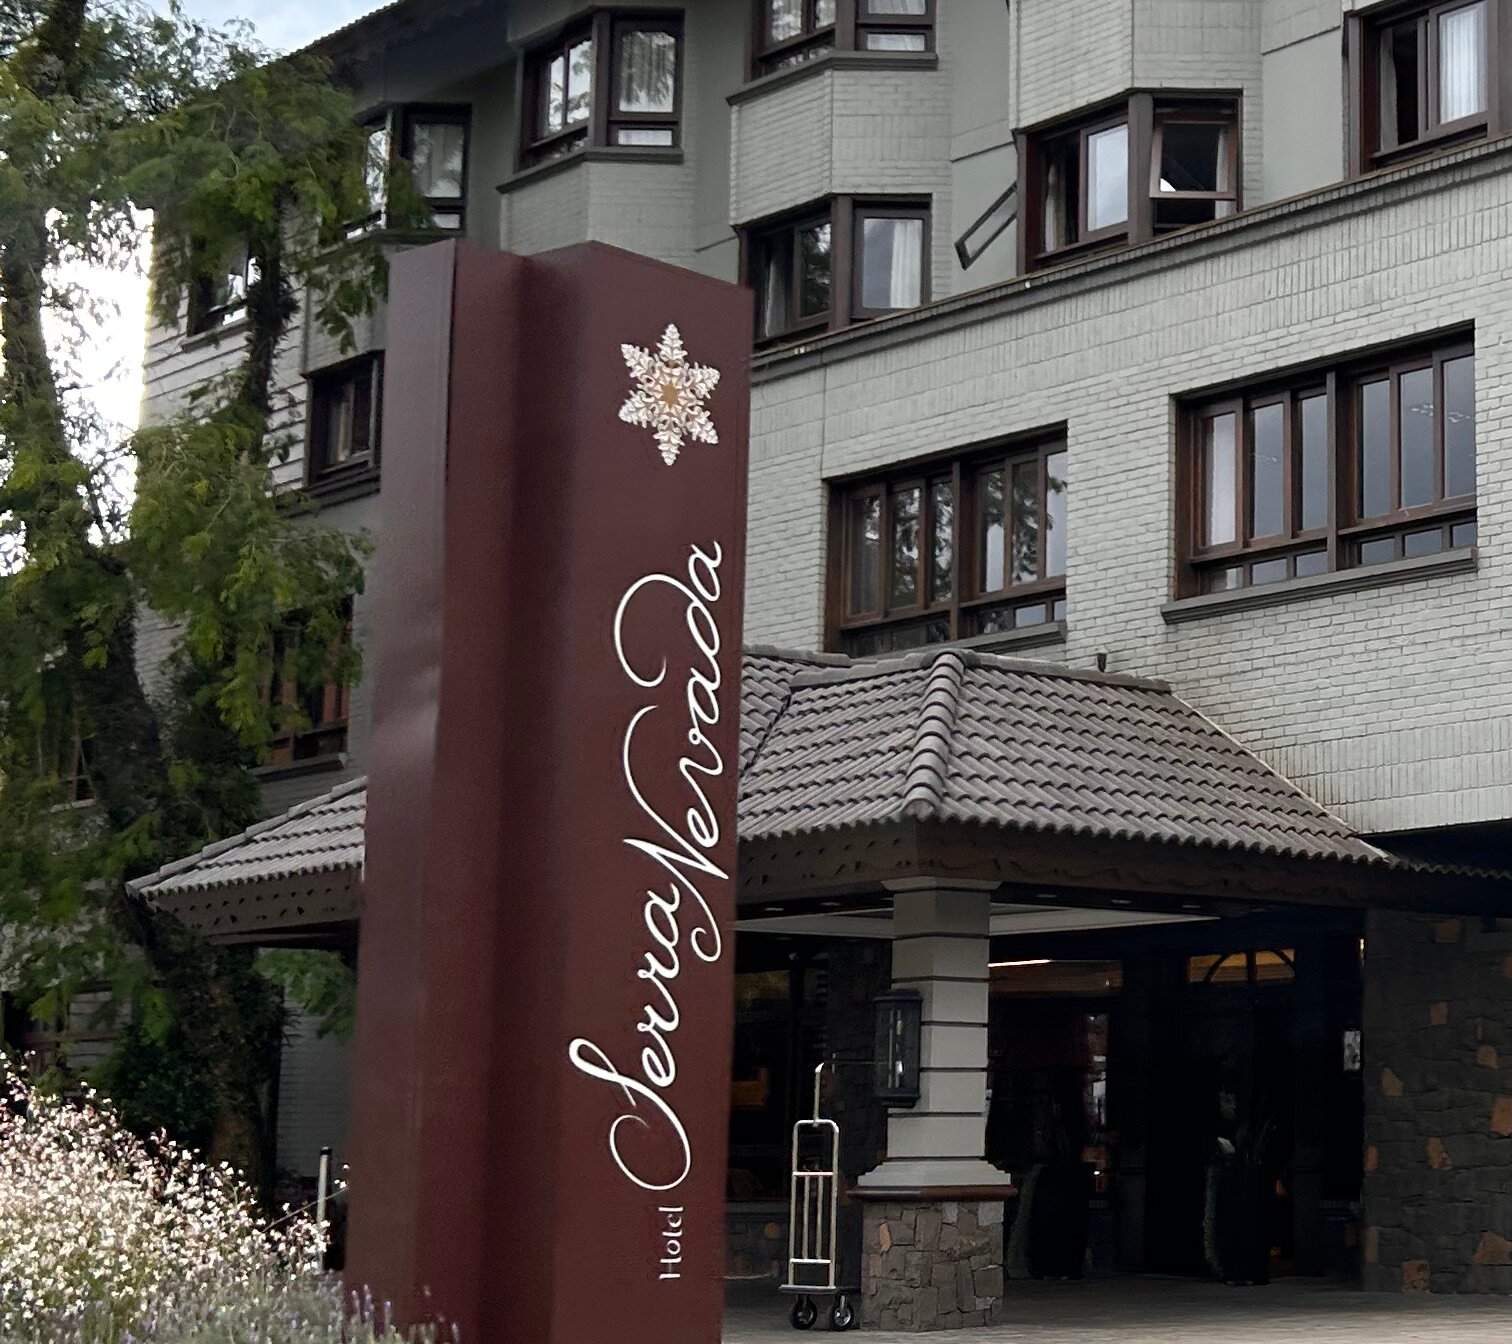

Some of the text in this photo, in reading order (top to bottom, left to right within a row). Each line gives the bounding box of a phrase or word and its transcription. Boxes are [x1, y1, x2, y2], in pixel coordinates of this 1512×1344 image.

[568, 540, 729, 1280] Hotel Serra Nevada
